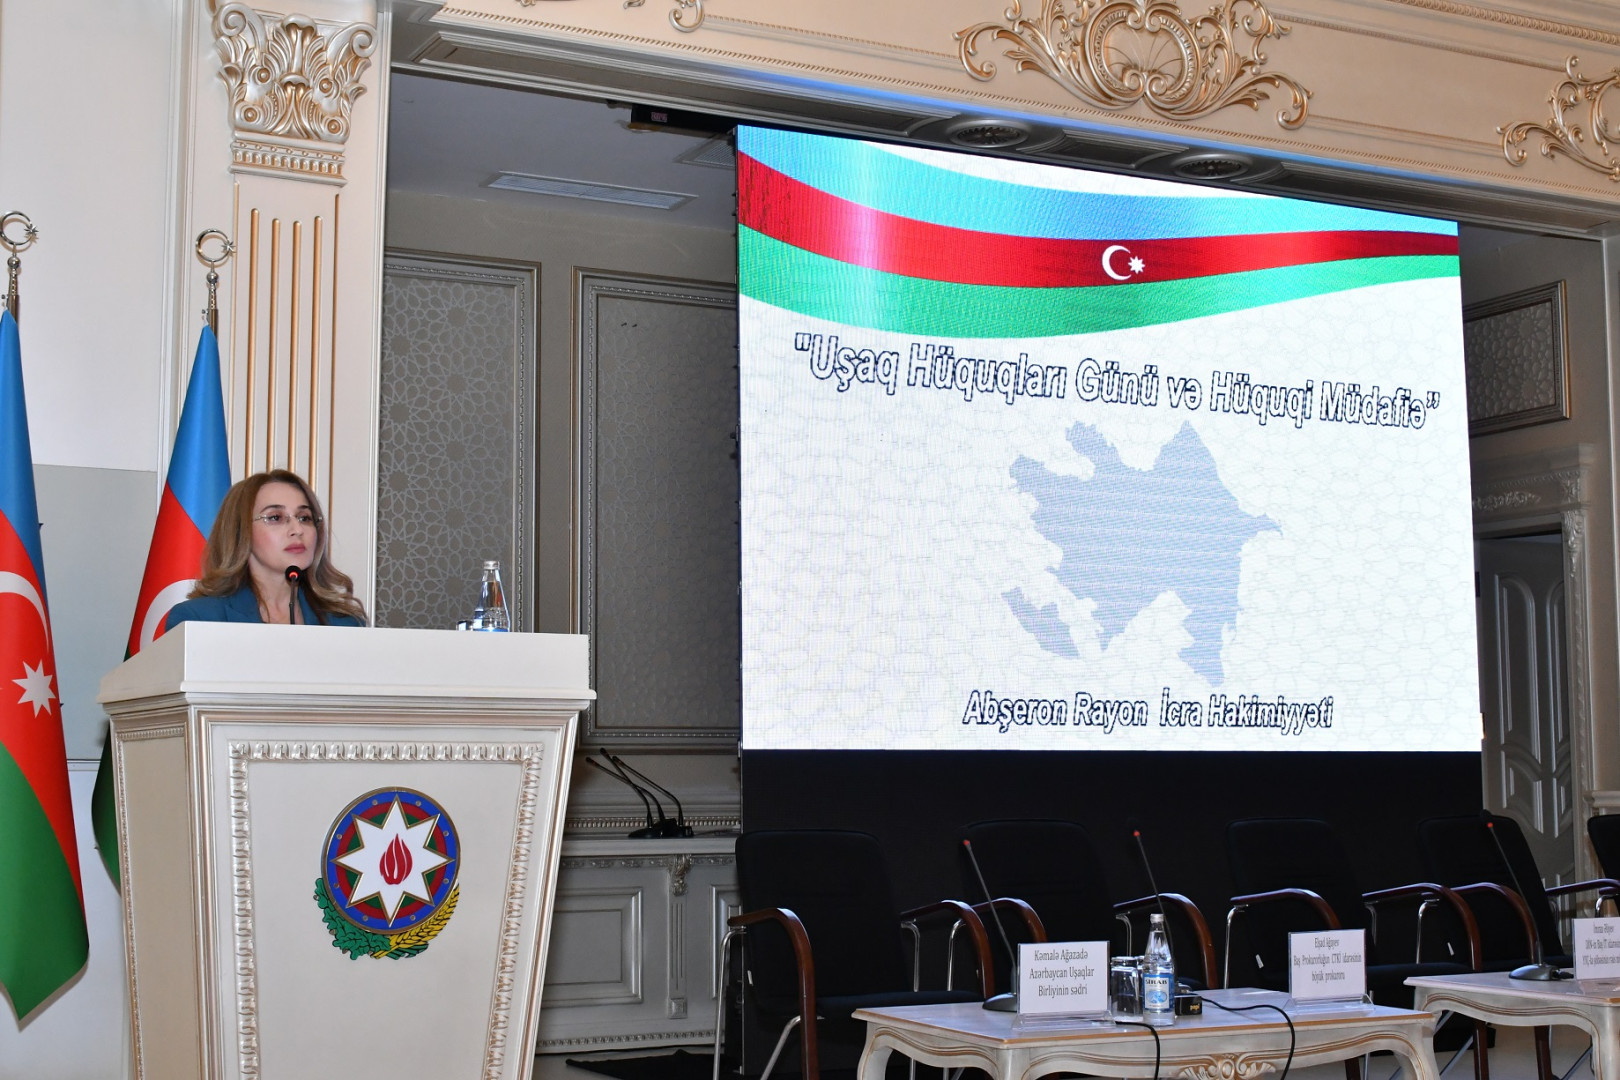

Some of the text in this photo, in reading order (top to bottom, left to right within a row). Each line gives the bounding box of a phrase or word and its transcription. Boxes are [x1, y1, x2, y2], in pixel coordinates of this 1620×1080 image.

[795, 332, 899, 395] "Uşaq
[907, 343, 1067, 405] Hüquqları
[1076, 358, 1160, 407] Günü
[1167, 376, 1202, 410] və
[1210, 371, 1314, 429] Hüquqi
[962, 687, 1334, 735] Abşeron Rayon İcra Hakimiyyəti
[1034, 948, 1088, 963] Kəmalə Ağazadə
[1029, 965, 1094, 981] Azərbaycan Uşaqlar
[1038, 984, 1087, 998] Birliyinin sədri
